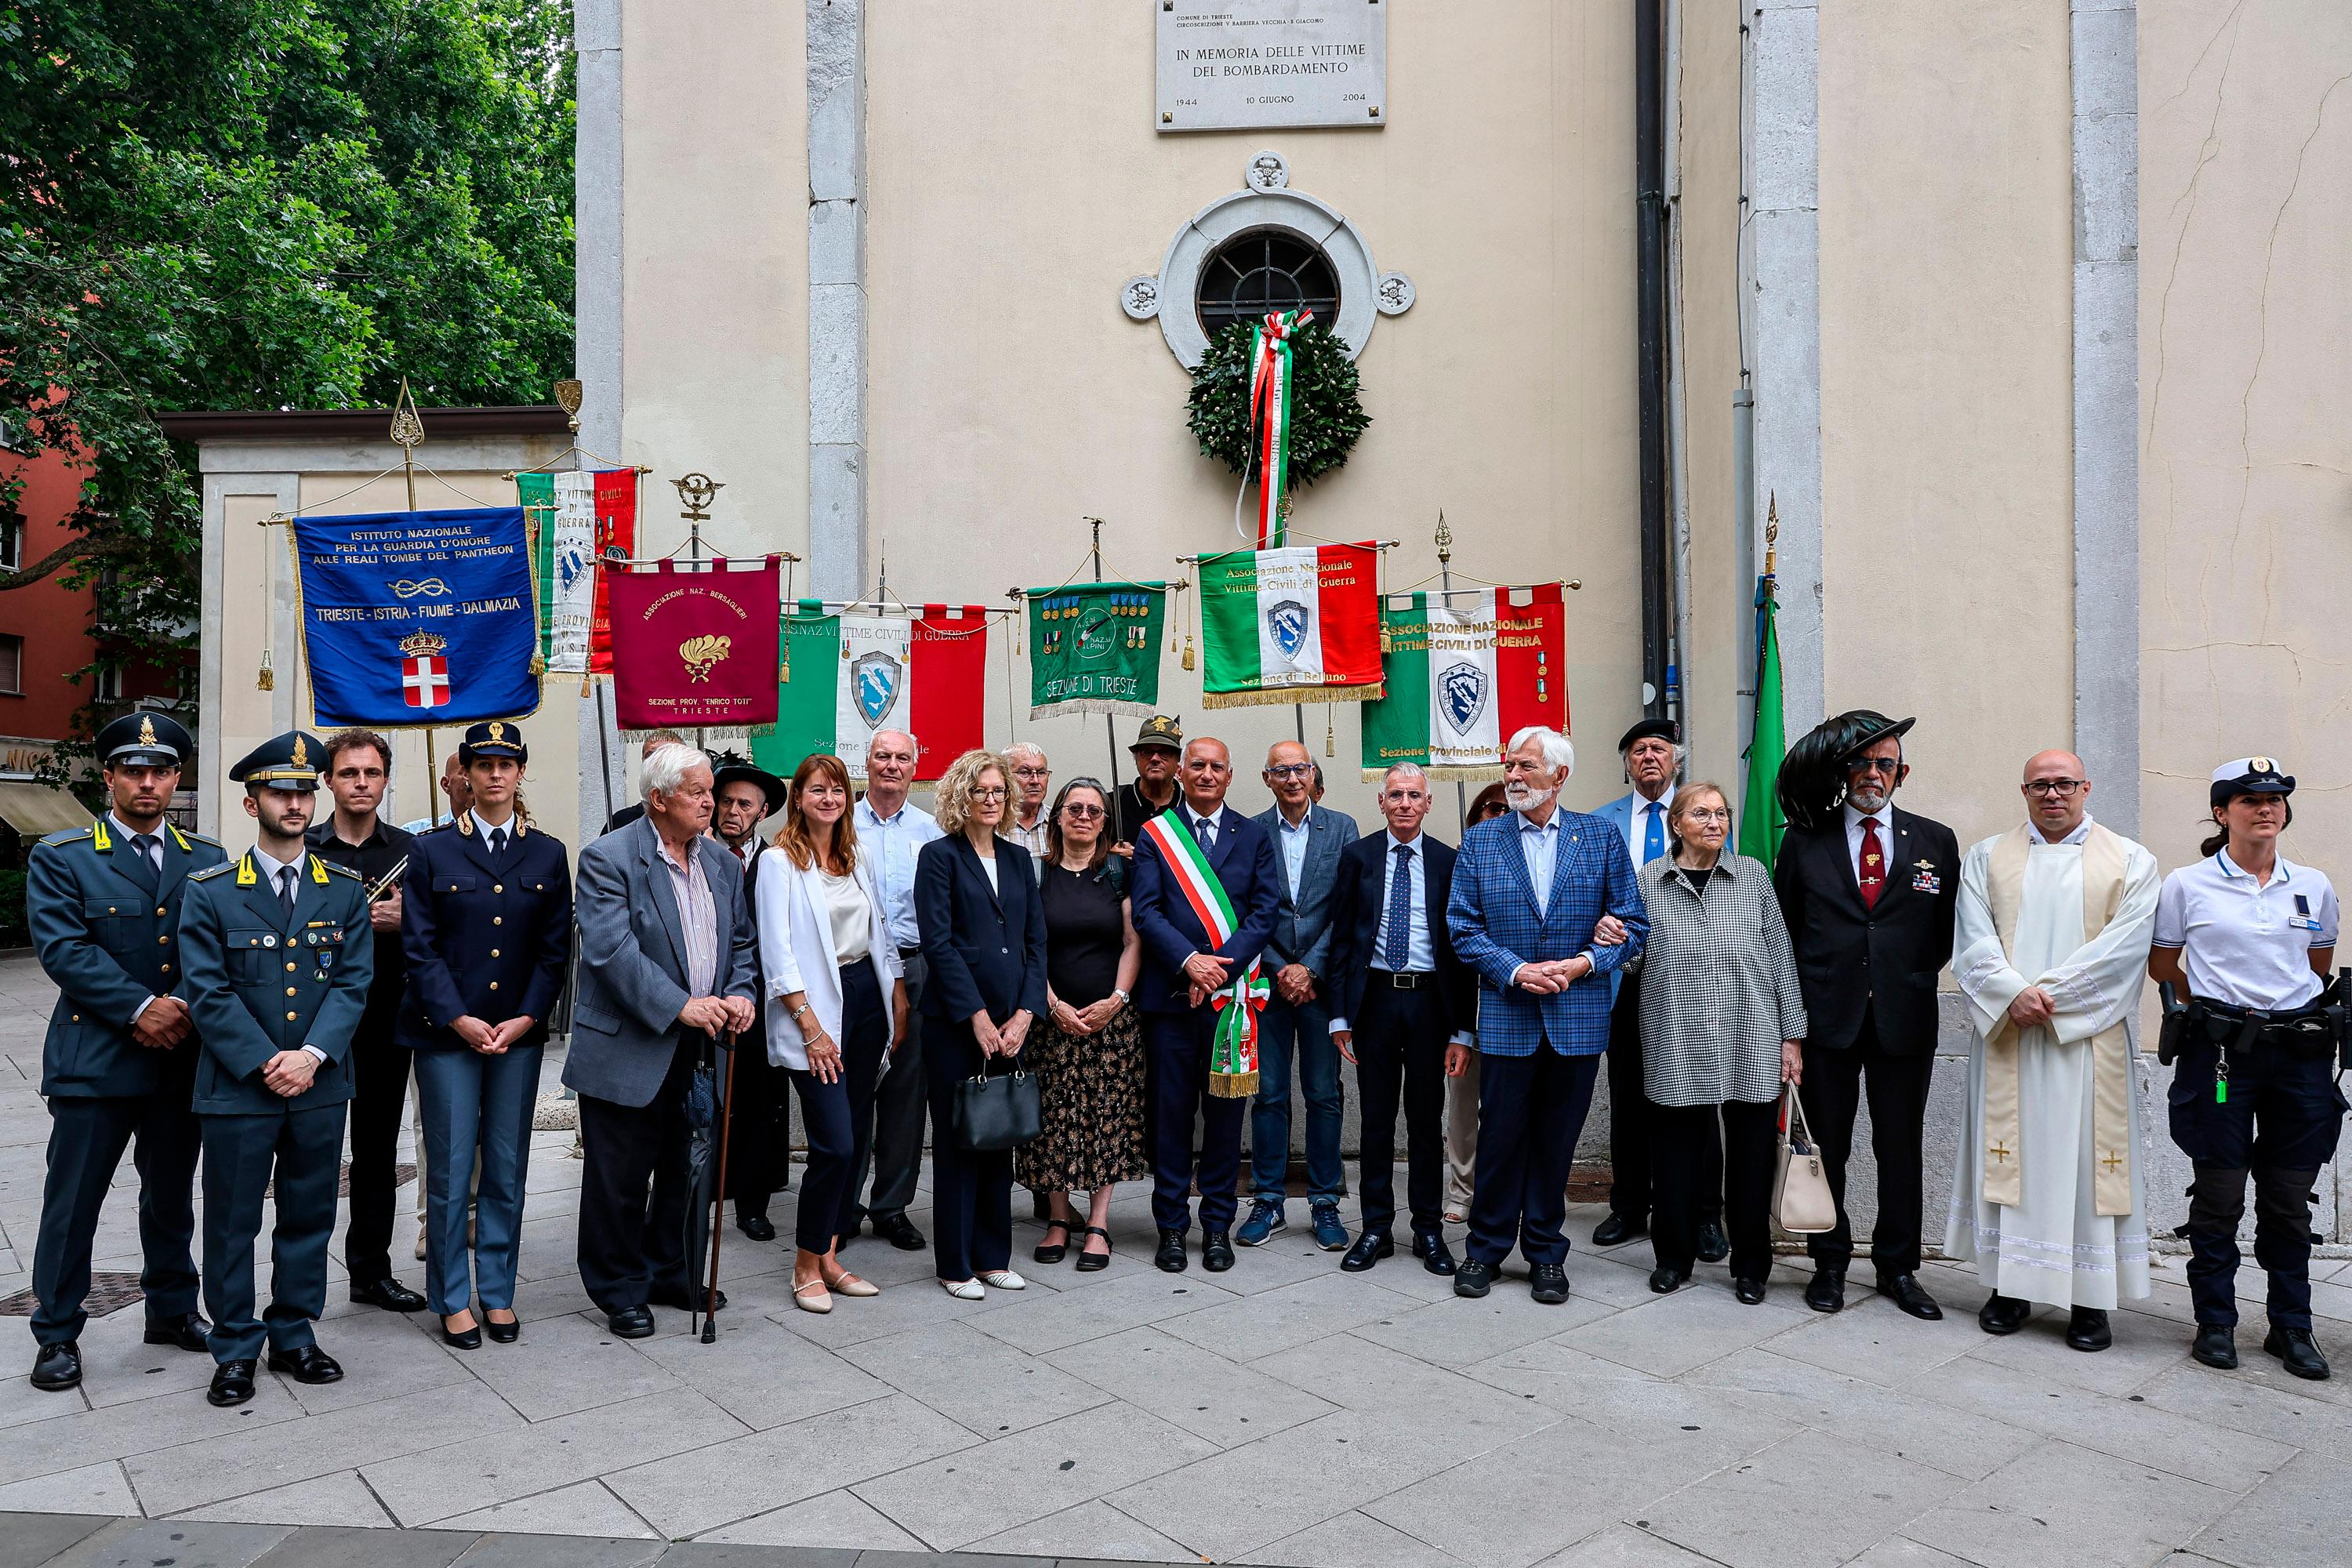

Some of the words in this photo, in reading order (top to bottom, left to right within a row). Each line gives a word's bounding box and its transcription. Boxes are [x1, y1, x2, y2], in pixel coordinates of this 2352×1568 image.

[1176, 49, 1189, 61] IN
[1196, 48, 1259, 60] MEMORIA
[1265, 45, 1305, 58] DELLE
[1311, 44, 1366, 56] VITTIME
[1192, 66, 1218, 78] DEL
[1223, 62, 1348, 77] BOMBARDAMENTO
[1258, 95, 1294, 103] GIUGNO
[1342, 93, 1366, 102] 2004
[567, 488, 595, 501] VITTIME
[600, 487, 622, 501] CIVILI
[568, 503, 577, 514] DI
[557, 517, 590, 528] GUERRA
[350, 530, 402, 541] ISTITUTO
[407, 526, 472, 539] NAZIONALE
[336, 543, 357, 553] PER
[363, 543, 379, 552] LA
[383, 540, 436, 551] GUARDIA
[441, 536, 491, 548] D'ONORE
[313, 554, 339, 565] ALLE
[344, 554, 379, 564] REALI
[382, 554, 423, 564] TOMBE
[428, 550, 449, 561] DEL
[455, 545, 514, 560] PANTHEON
[1225, 564, 1294, 579] Associazione
[1299, 560, 1352, 575] Nazionale
[1224, 583, 1261, 593] Vittime
[1267, 579, 1297, 590] Civili
[1302, 579, 1312, 589] di
[1318, 576, 1356, 588] Guerra
[315, 608, 365, 622] TRIESTE
[373, 607, 411, 620] ISTRIA
[419, 603, 455, 618] FIUME
[463, 597, 521, 614] DALMAZIA
[642, 589, 684, 621] ASSOCIAZIONE
[710, 590, 747, 620] BERSAGLIERI
[875, 629, 907, 641] CIVILI
[910, 630, 921, 641] DI
[924, 630, 970, 641] GUERRA
[1389, 622, 1471, 636] SSOCIAZIONE
[1472, 618, 1544, 634] NAZIONALE
[1391, 639, 1434, 652] ITTIME
[1435, 639, 1472, 652] CIVILI
[1474, 638, 1487, 650] DI
[1490, 634, 1542, 648] GUERRA
[1047, 677, 1078, 698] SEZIONE
[1082, 676, 1093, 693] DI
[1099, 677, 1138, 695] TRIESTE
[1240, 675, 1283, 687] Sezione
[1287, 671, 1297, 682] di
[1304, 671, 1346, 682] Belluno
[814, 738, 860, 752] Sezione
[1379, 746, 1425, 758] Sezione
[1428, 745, 1493, 757] Provinciale
[1494, 742, 1507, 754] di
